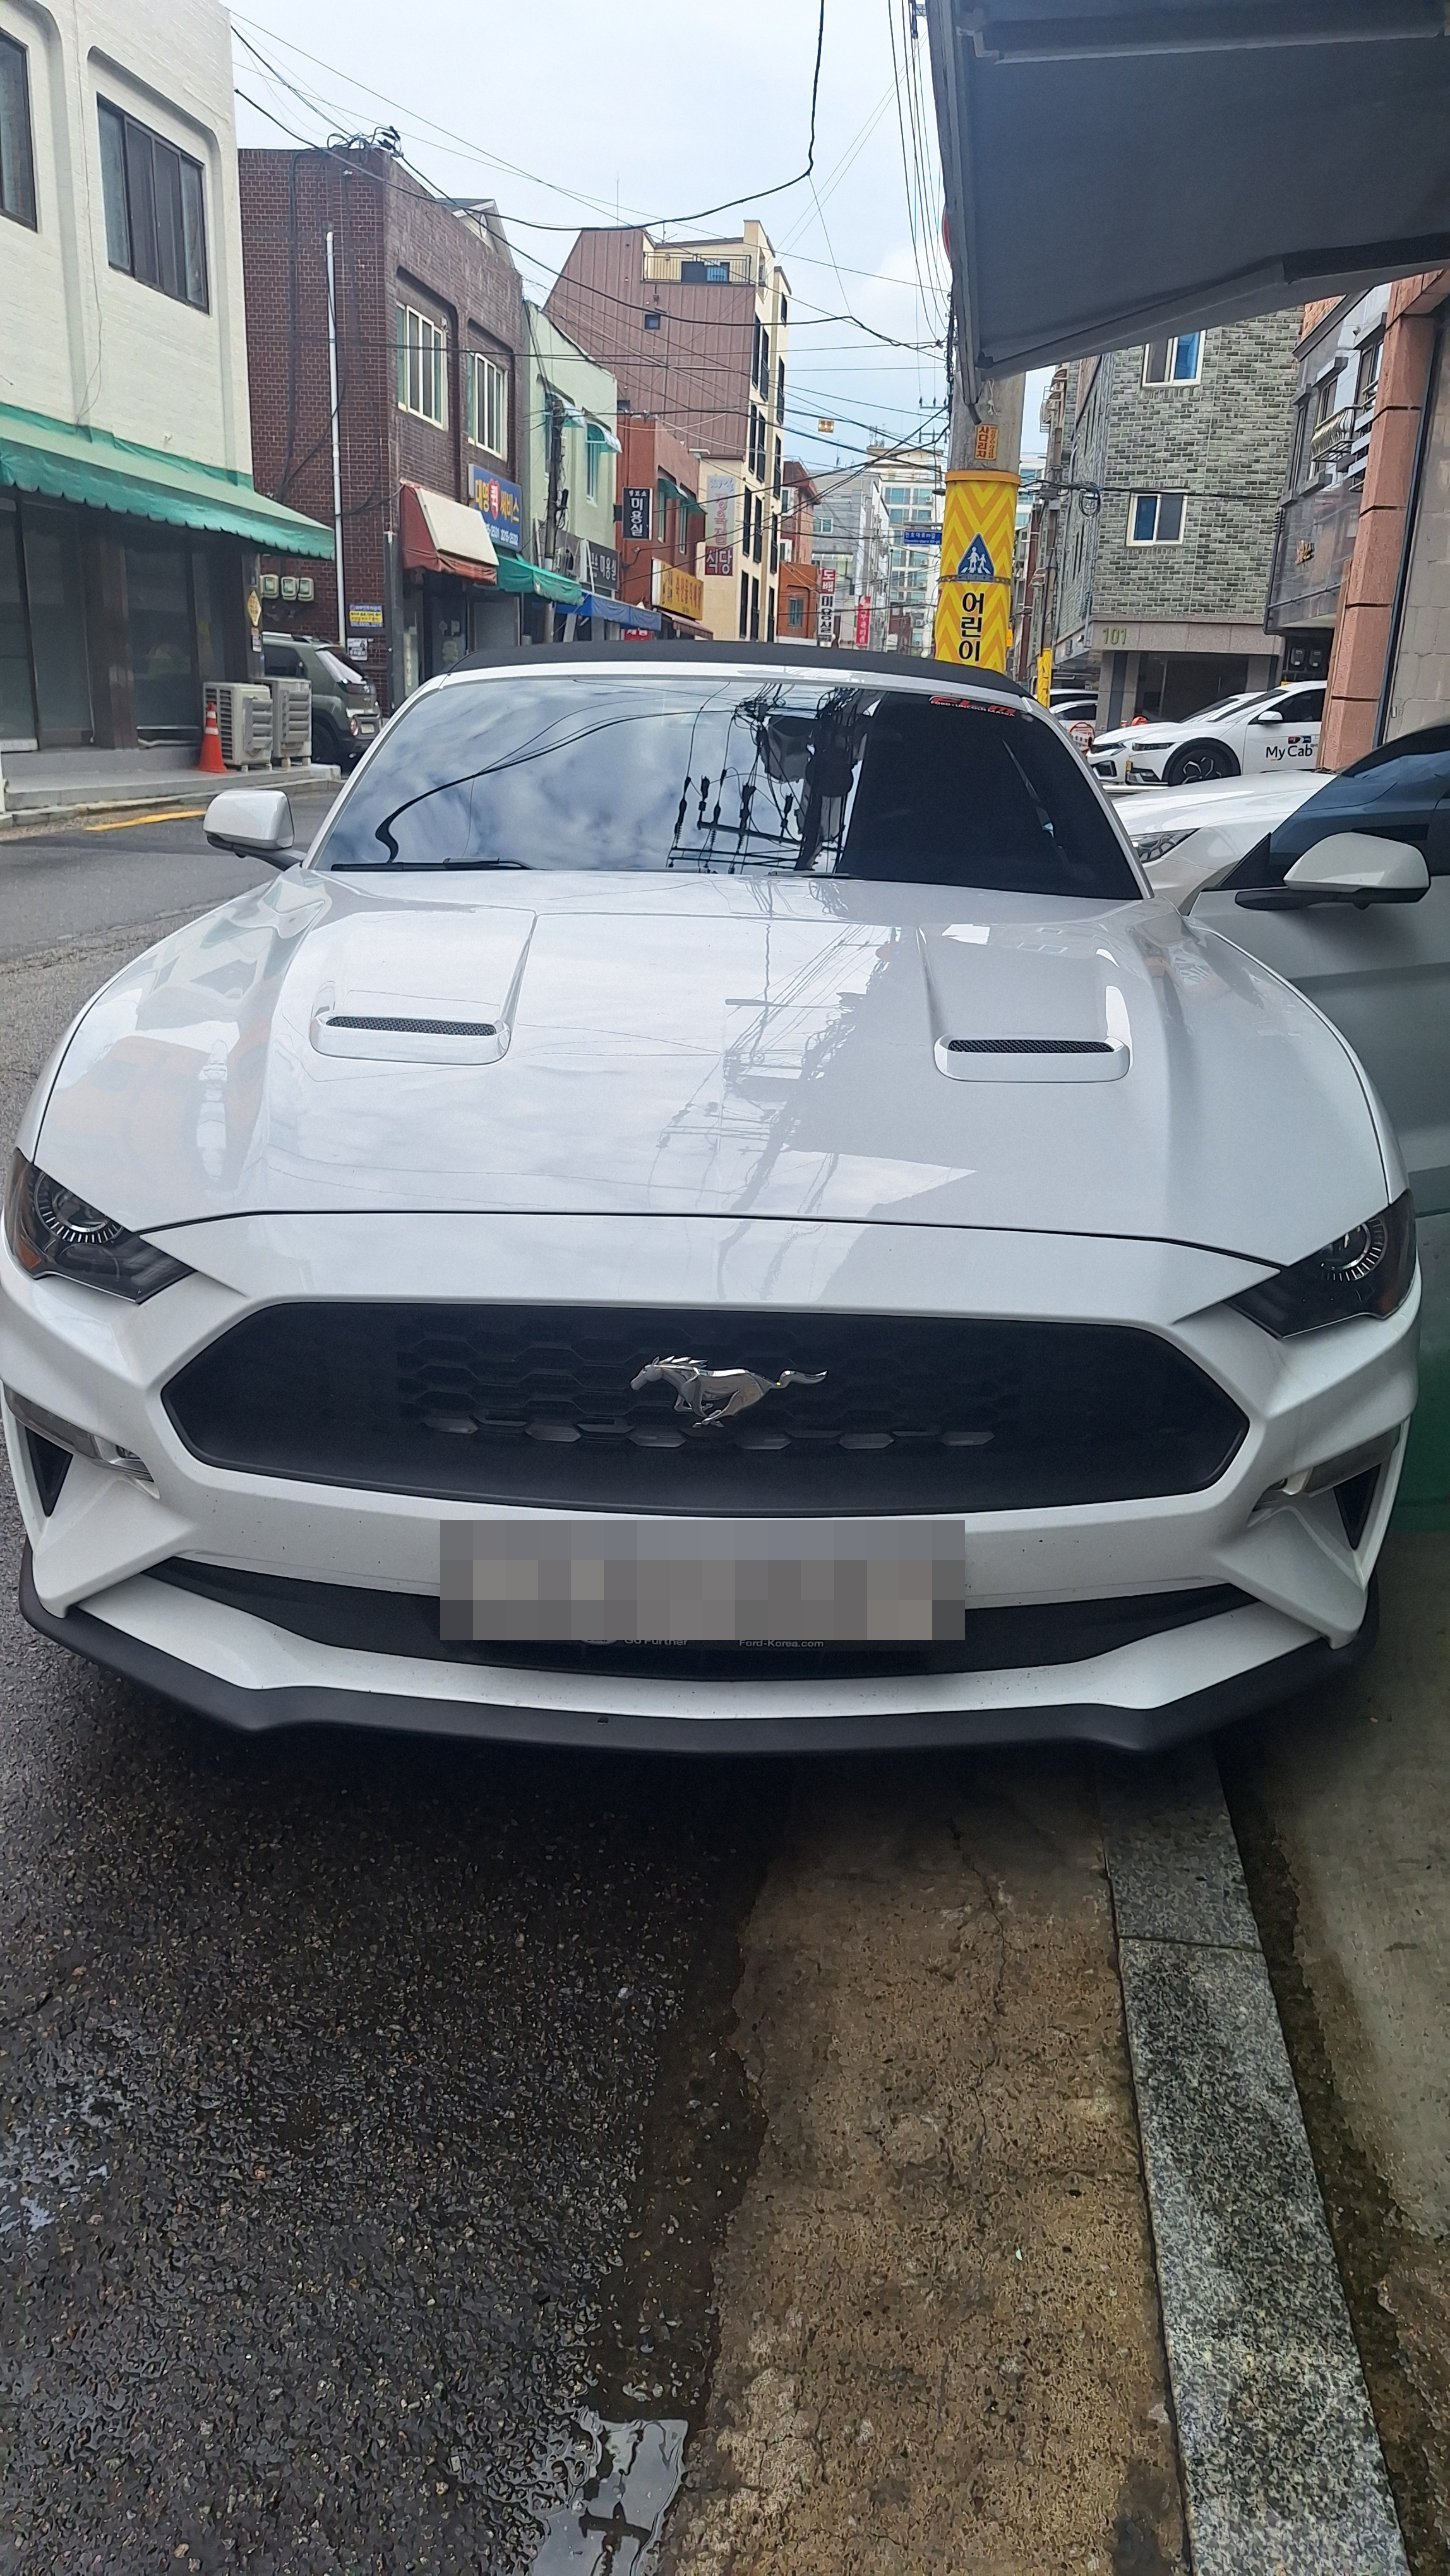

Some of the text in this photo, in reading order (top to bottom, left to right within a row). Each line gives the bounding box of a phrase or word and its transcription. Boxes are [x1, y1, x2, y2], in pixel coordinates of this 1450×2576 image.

[630, 497, 644, 537] 미용실
[600, 555, 616, 581] 미용실
[706, 549, 733, 574] 식당
[820, 595, 834, 634] 미용실
[958, 592, 985, 663] 어린이
[1102, 627, 1127, 645] 101
[739, 1640, 824, 1648] Ford-Korea.com
